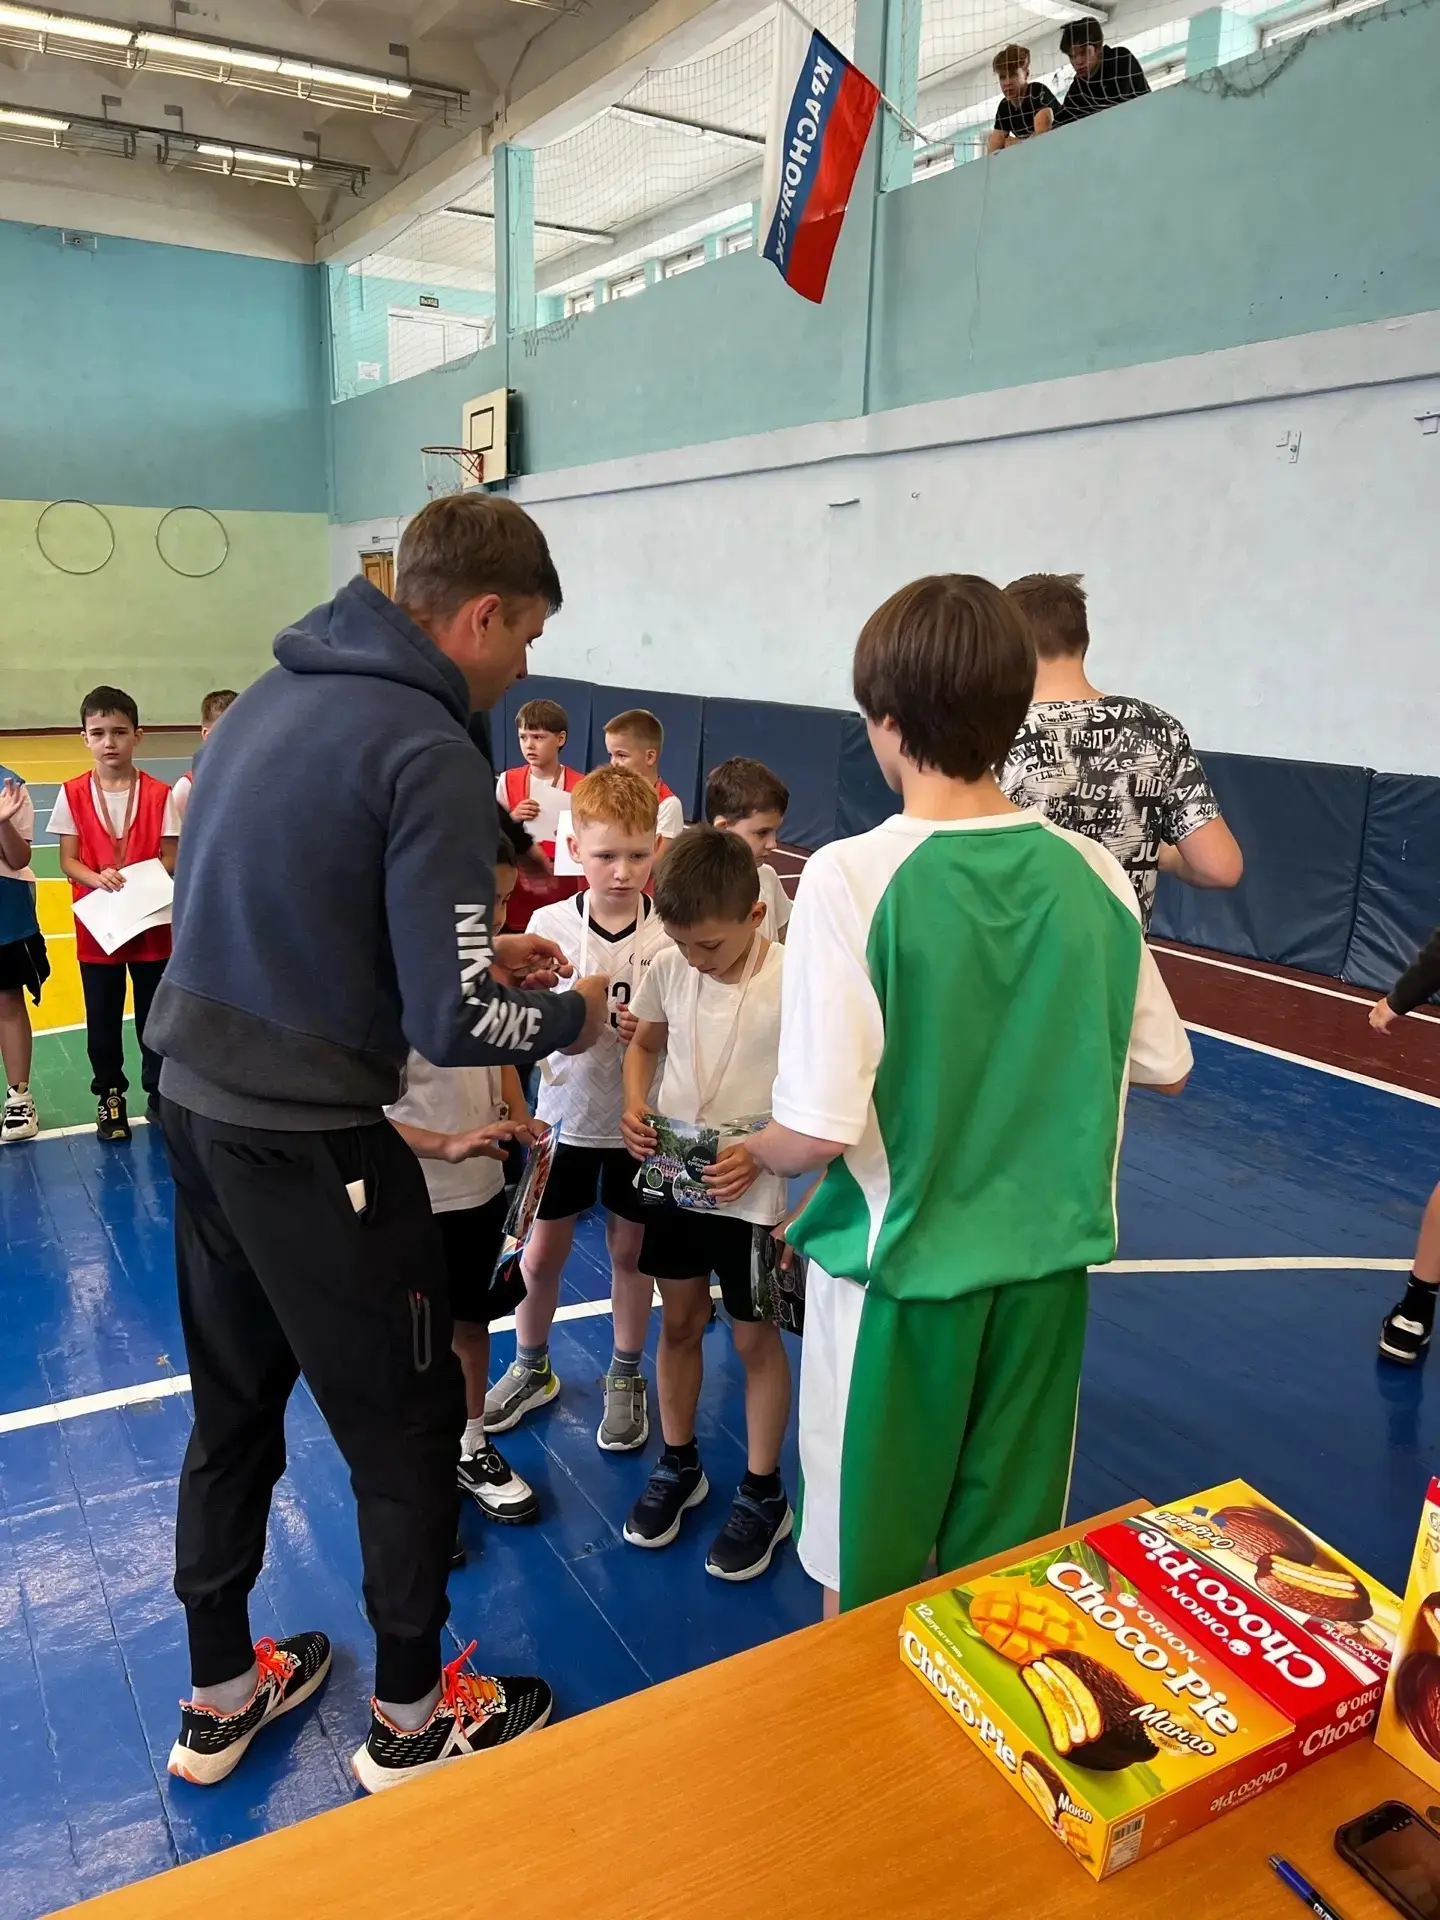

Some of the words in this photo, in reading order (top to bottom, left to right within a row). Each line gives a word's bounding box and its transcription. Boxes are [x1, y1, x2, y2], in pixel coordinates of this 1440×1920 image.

[1069, 781, 1119, 802] JUST
[1155, 1511, 1235, 1550] Original
[915, 1602, 934, 1619] 12
[1167, 1585, 1229, 1638] ORION
[1137, 1609, 1200, 1664] ORION
[946, 1664, 982, 1708] ORION
[1129, 1702, 1216, 1756] Манго
[1058, 1792, 1093, 1824] Манго
